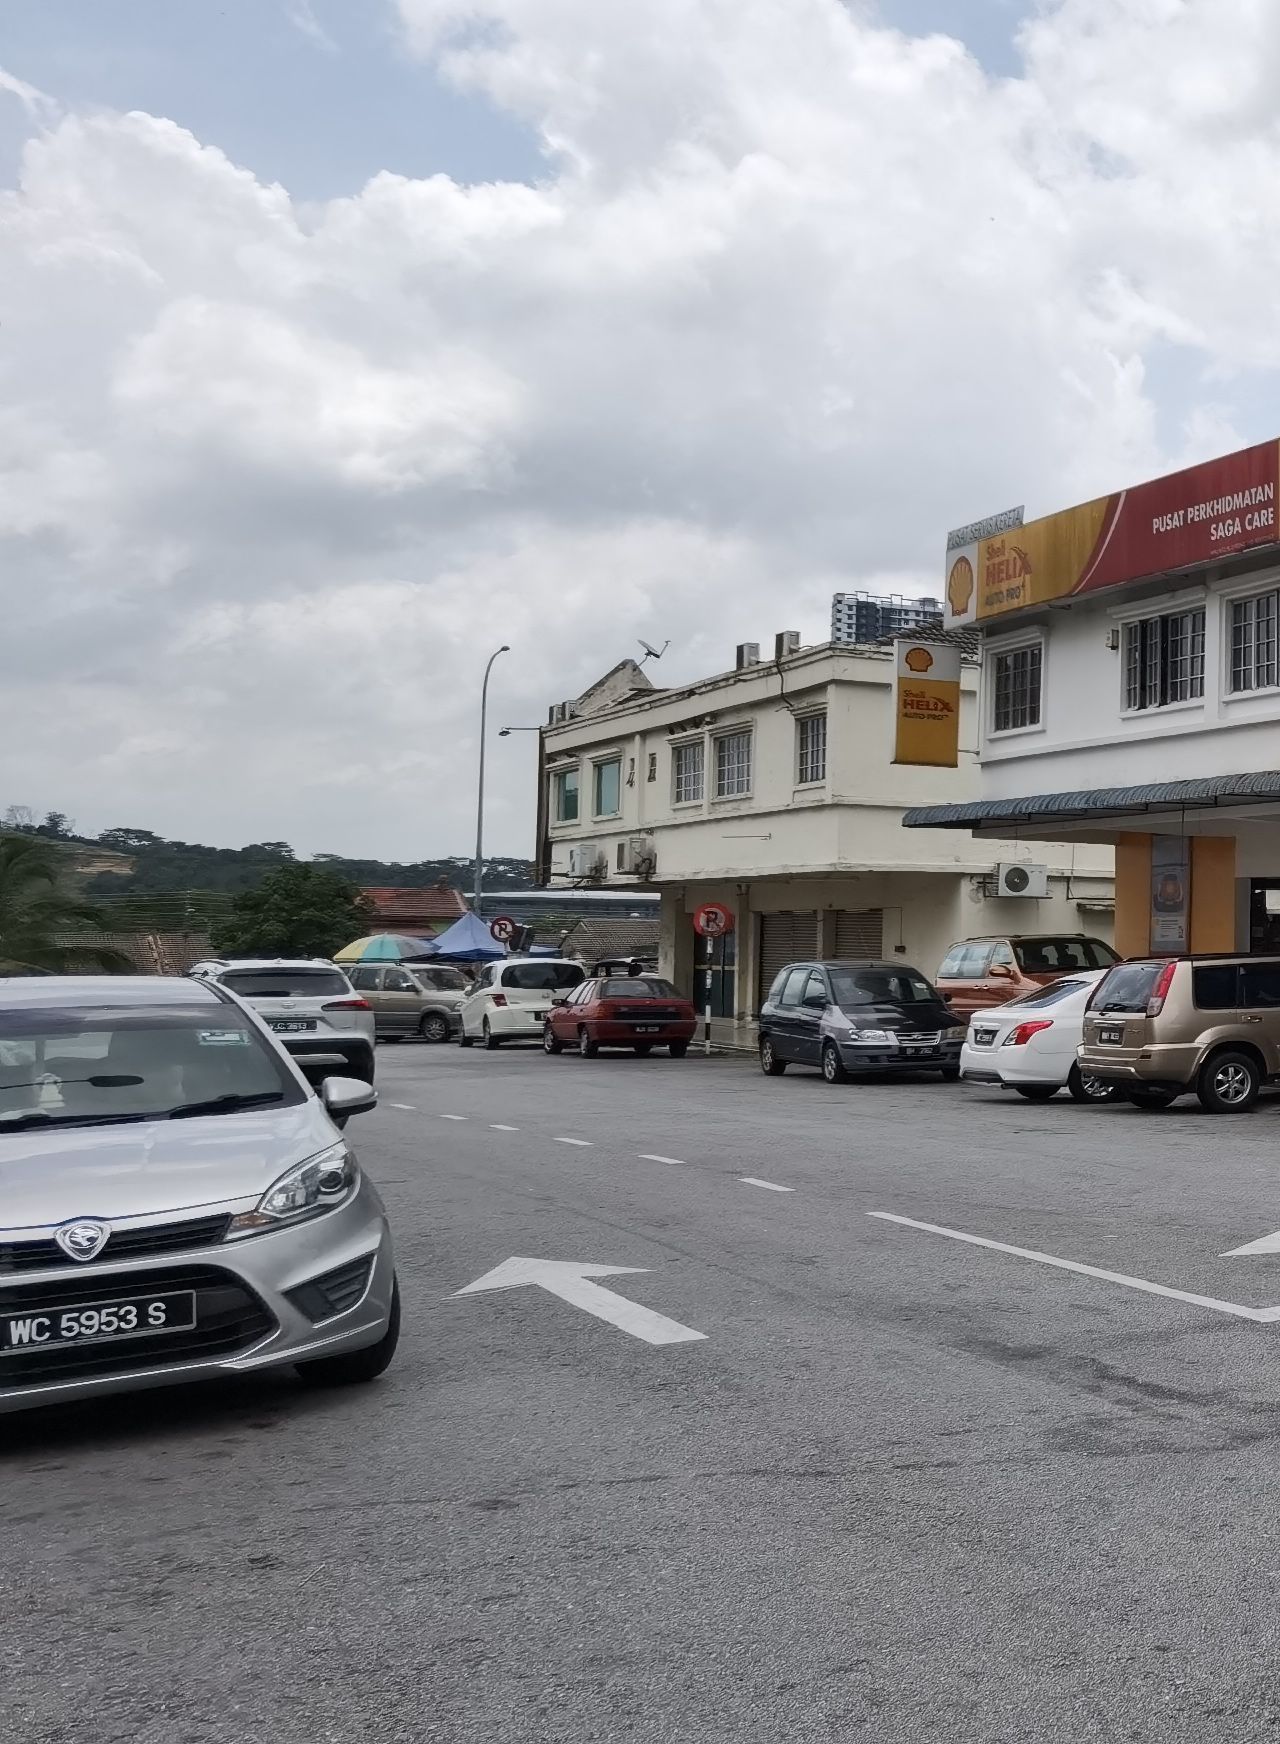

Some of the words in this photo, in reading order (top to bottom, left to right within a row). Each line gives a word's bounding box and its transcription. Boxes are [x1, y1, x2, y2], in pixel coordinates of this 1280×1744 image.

[1152, 511, 1184, 534] PUSAT
[1187, 482, 1274, 523] PERKHIDMATAN
[1210, 517, 1242, 541] SAGA
[1245, 507, 1274, 531] CARE
[985, 547, 1032, 587] HELIX
[986, 539, 1006, 562] Shell
[903, 697, 954, 713] HELIX
[10, 1317, 51, 1345] WC
[60, 1305, 138, 1338] 5953
[147, 1302, 167, 1326] S
